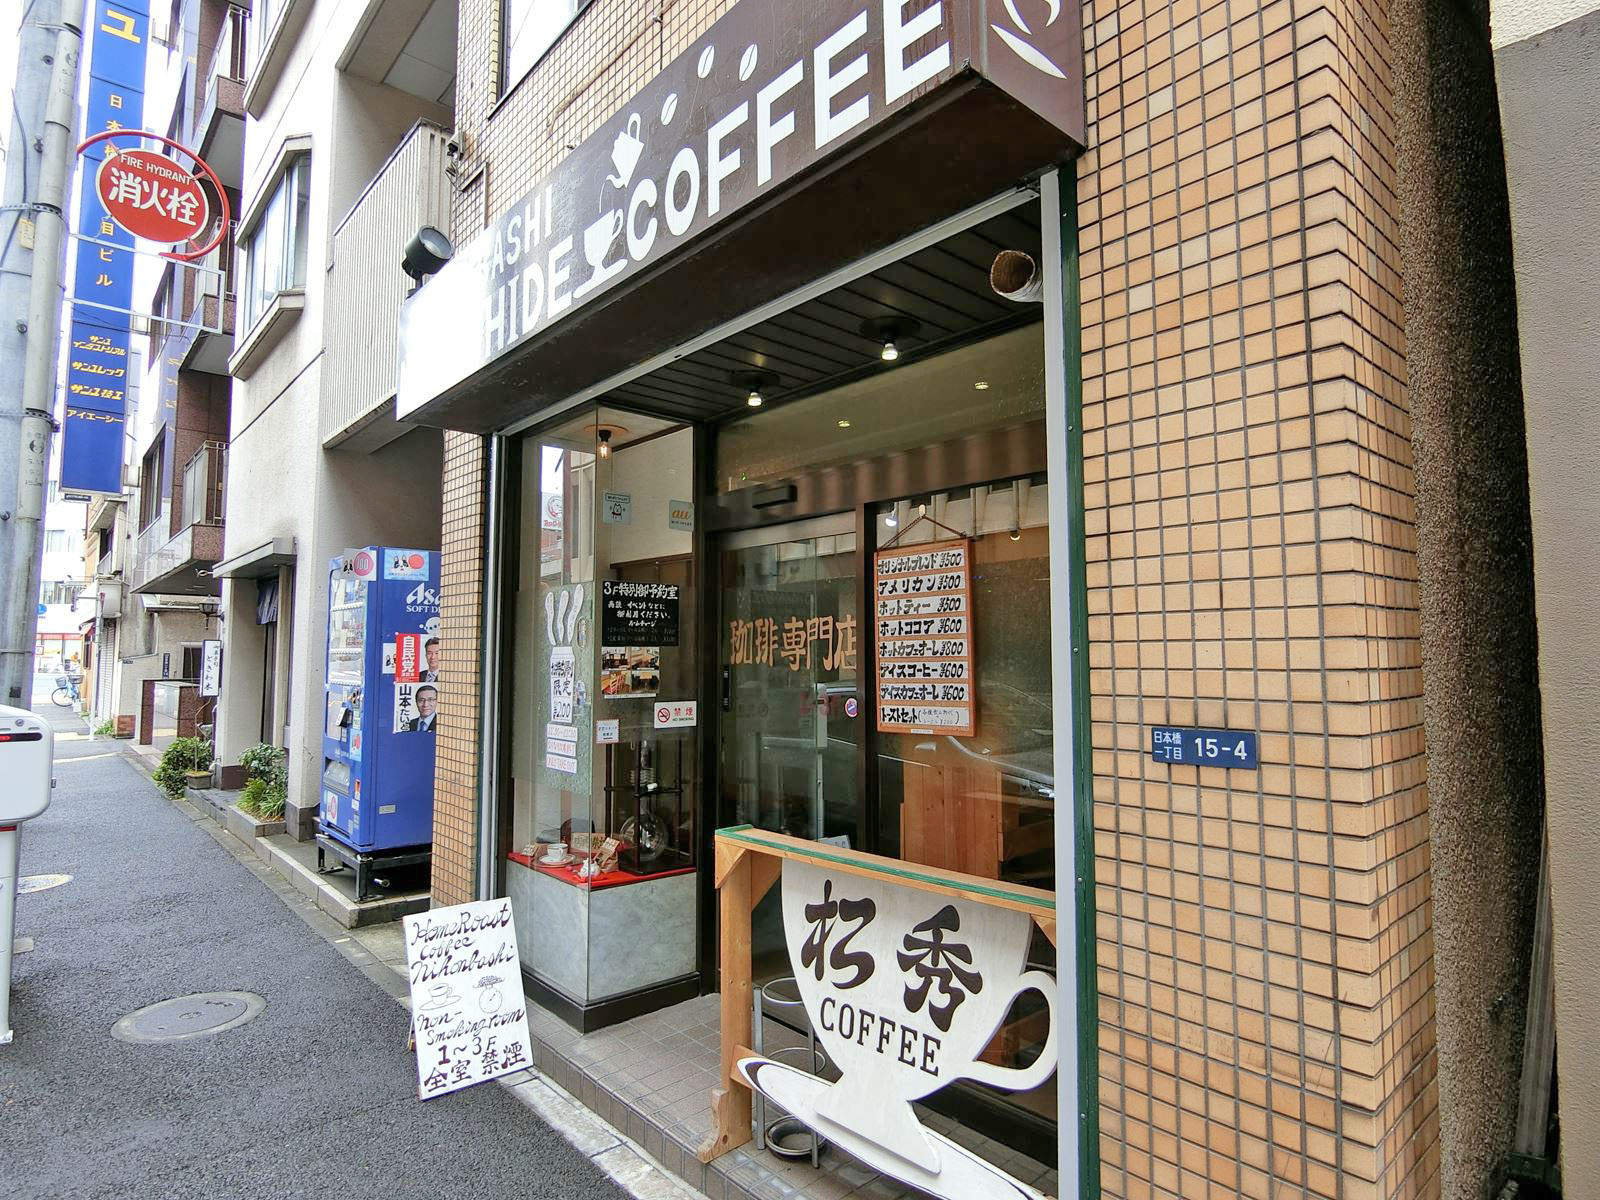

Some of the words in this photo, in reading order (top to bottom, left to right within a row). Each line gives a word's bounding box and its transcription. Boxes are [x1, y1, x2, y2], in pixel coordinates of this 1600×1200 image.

[626, 0, 950, 262] COFFEE
[120, 154, 143, 170] FIRE
[147, 163, 191, 185] HYDRANT
[108, 166, 200, 226] 消火栓
[482, 236, 574, 358] HIDE
[71, 361, 125, 378] サンユレック
[878, 552, 938, 574] オリジナルブレンド
[939, 552, 962, 568] ¥500
[879, 576, 936, 595] アメリカン
[937, 574, 961, 590] ¥500
[406, 605, 430, 613] SOFT
[879, 599, 931, 616] ホットティー
[937, 597, 961, 613] ¥500
[880, 619, 934, 636] ホットココア
[938, 617, 962, 634] ¥600
[729, 614, 857, 671] 珈琲専門店
[880, 640, 939, 656] ホットカフェオーレ
[402, 636, 414, 677] 自民党
[880, 663, 938, 678] アイスコーヒー
[939, 662, 964, 678] ¥600
[881, 684, 939, 700] アイスカフェオーレ
[941, 684, 965, 701] ¥600
[673, 706, 694, 717] 禁煙
[1154, 731, 1182, 745] 日本橋
[1154, 746, 1182, 760] 一丁目
[1194, 737, 1248, 760] 15-4
[820, 996, 942, 1077] COFFEE
